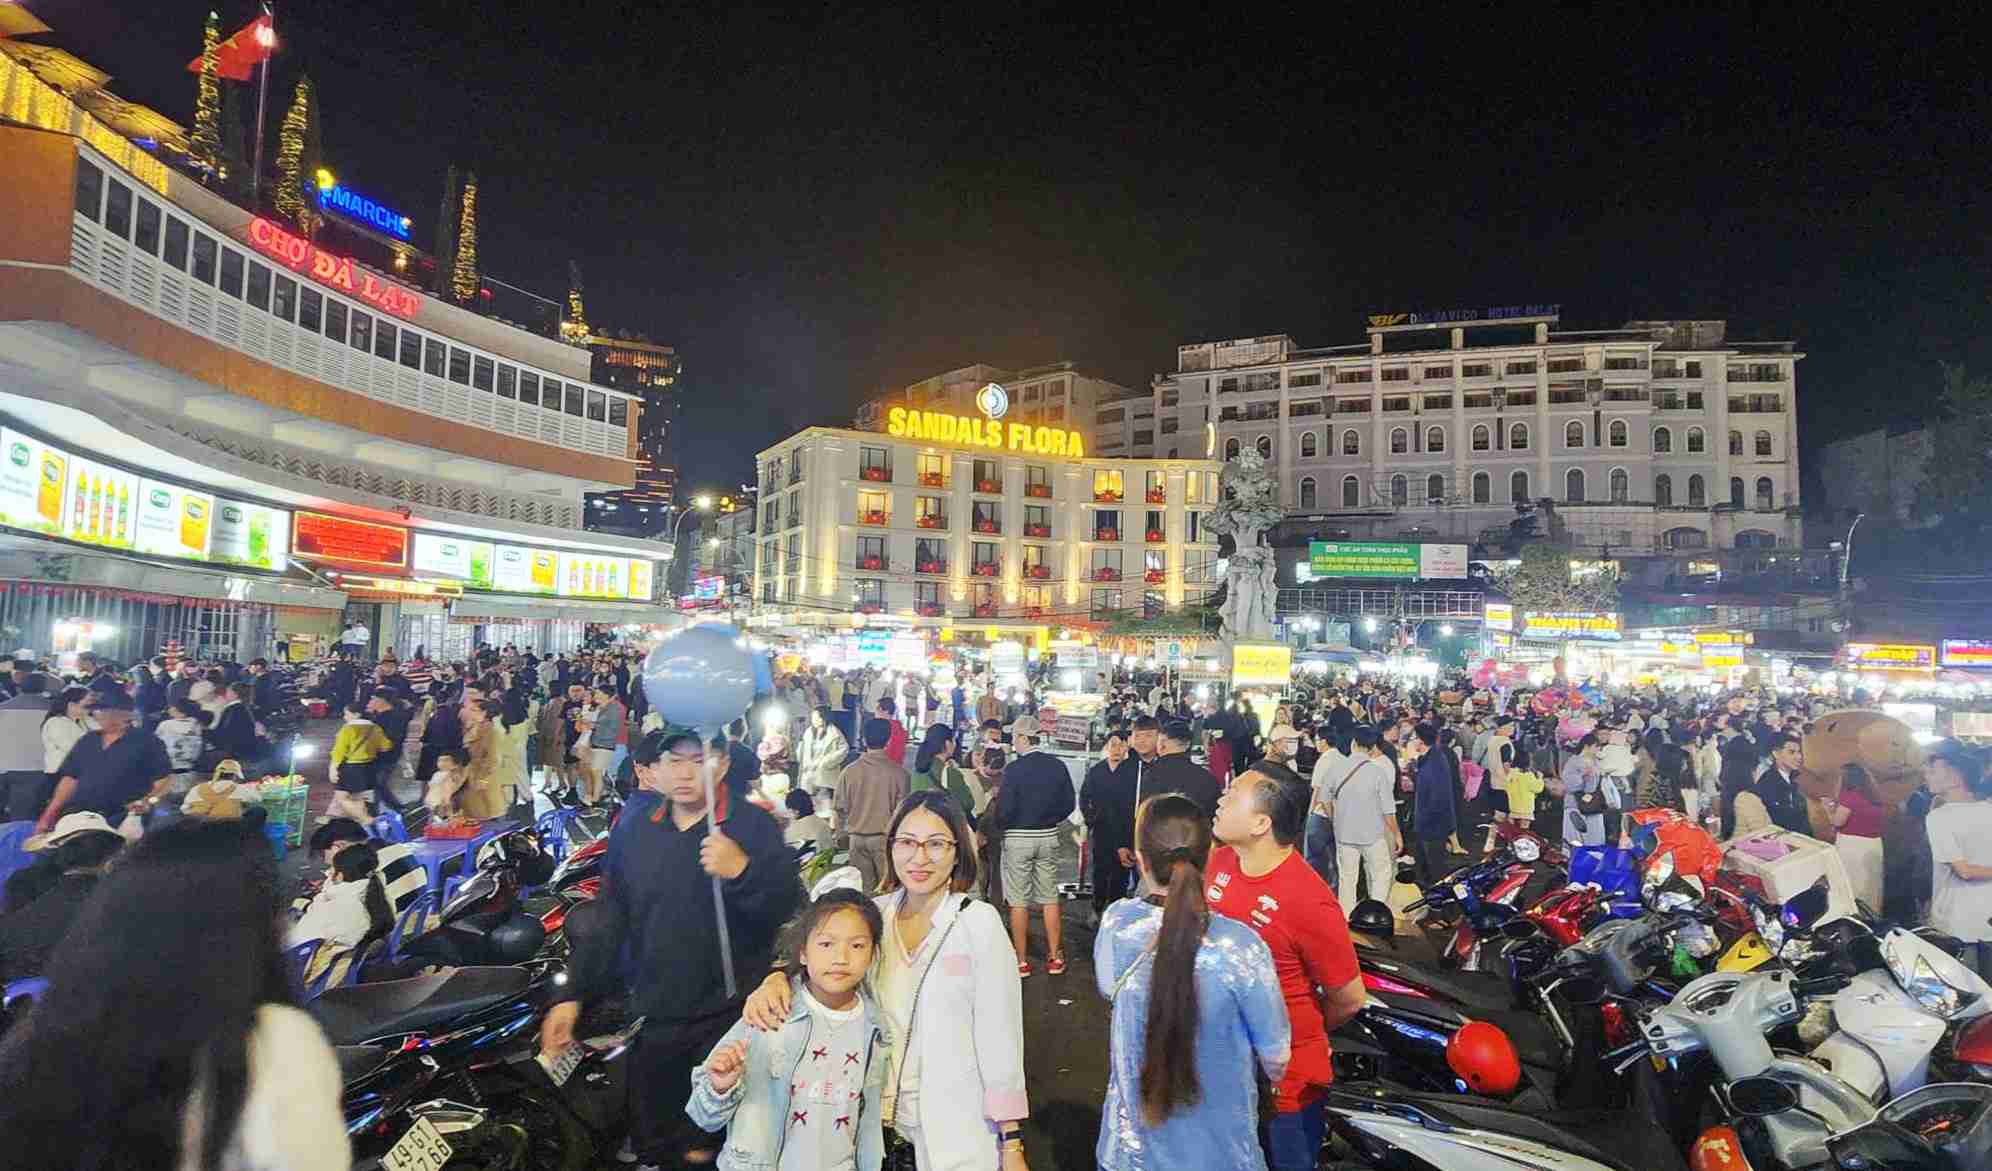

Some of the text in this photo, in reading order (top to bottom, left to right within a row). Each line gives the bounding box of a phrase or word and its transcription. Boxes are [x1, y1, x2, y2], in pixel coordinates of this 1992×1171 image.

[250, 217, 418, 317] CHỢ ĐÀ LẠT
[888, 406, 1084, 457] SANDALS FLORA
